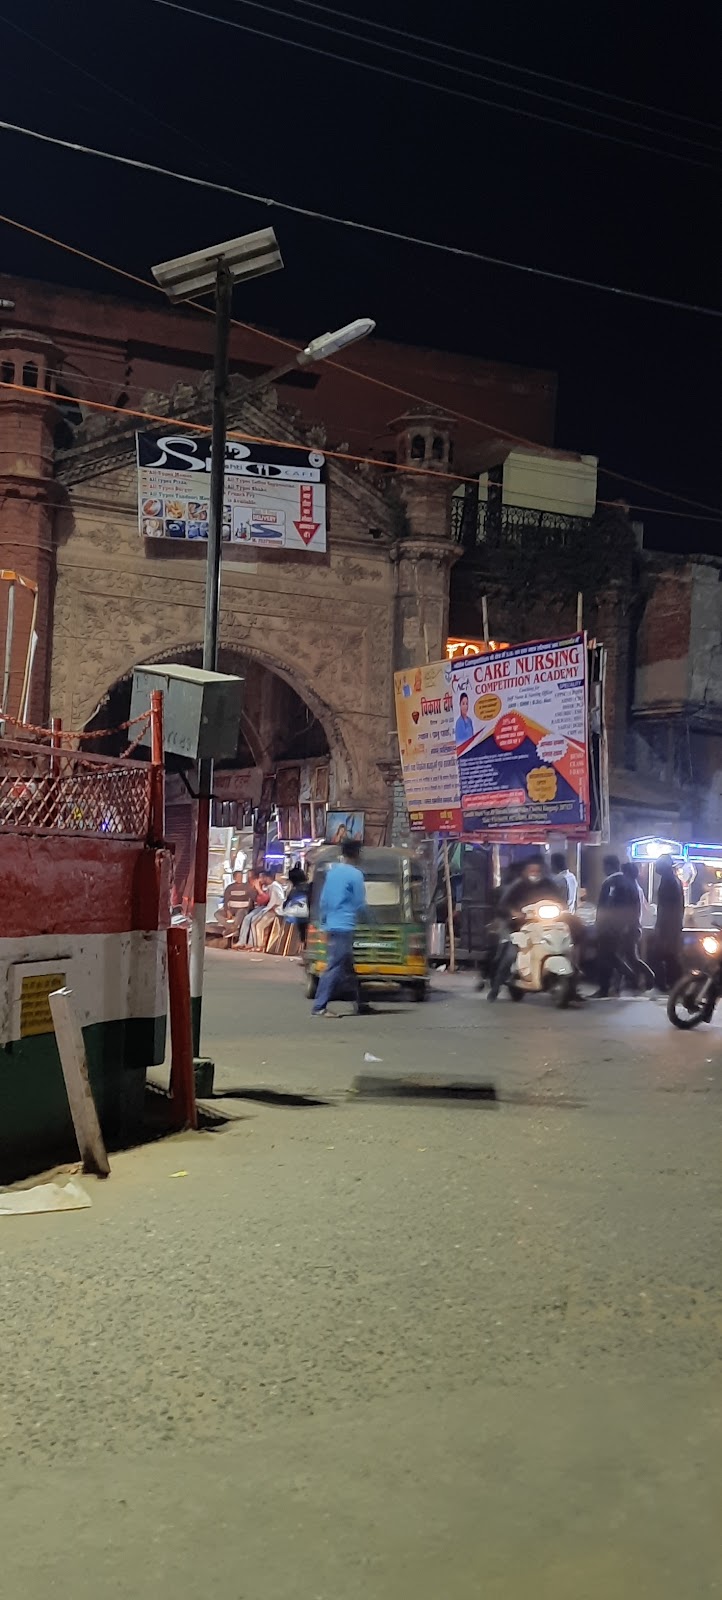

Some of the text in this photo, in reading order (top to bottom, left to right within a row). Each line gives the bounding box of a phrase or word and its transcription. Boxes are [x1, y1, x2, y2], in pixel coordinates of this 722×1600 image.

[252, 514, 276, 522] DELIVERY
[473, 647, 580, 683] CARE NURSING
[475, 666, 579, 695] COMPETITION ACADEMY
[421, 696, 441, 717] विकास
